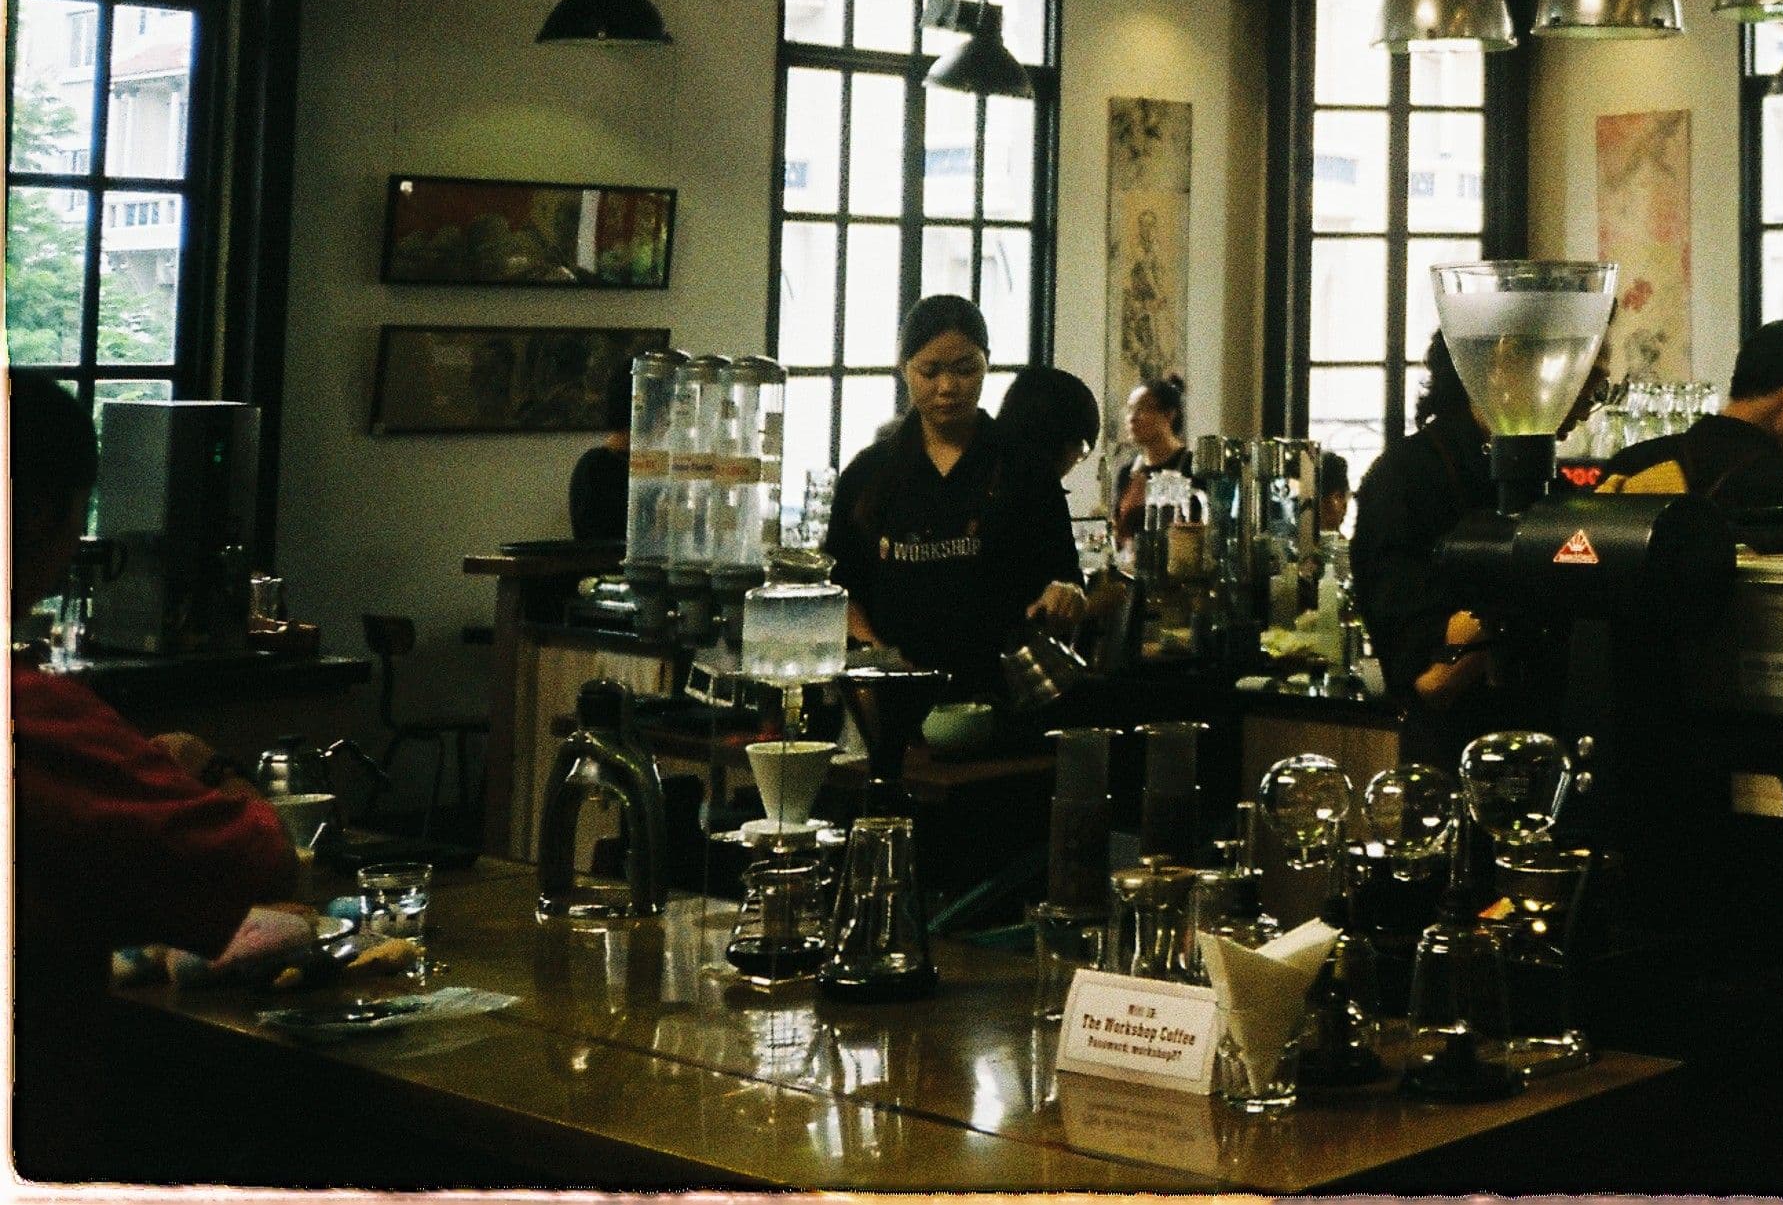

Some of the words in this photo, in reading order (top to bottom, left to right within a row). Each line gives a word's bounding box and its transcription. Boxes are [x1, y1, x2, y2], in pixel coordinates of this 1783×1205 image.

[894, 537, 981, 562] WORKSHOP
[1082, 1013, 1101, 1030] The
[1104, 1017, 1158, 1043] Workshop
[1159, 1026, 1196, 1046] Coffee
